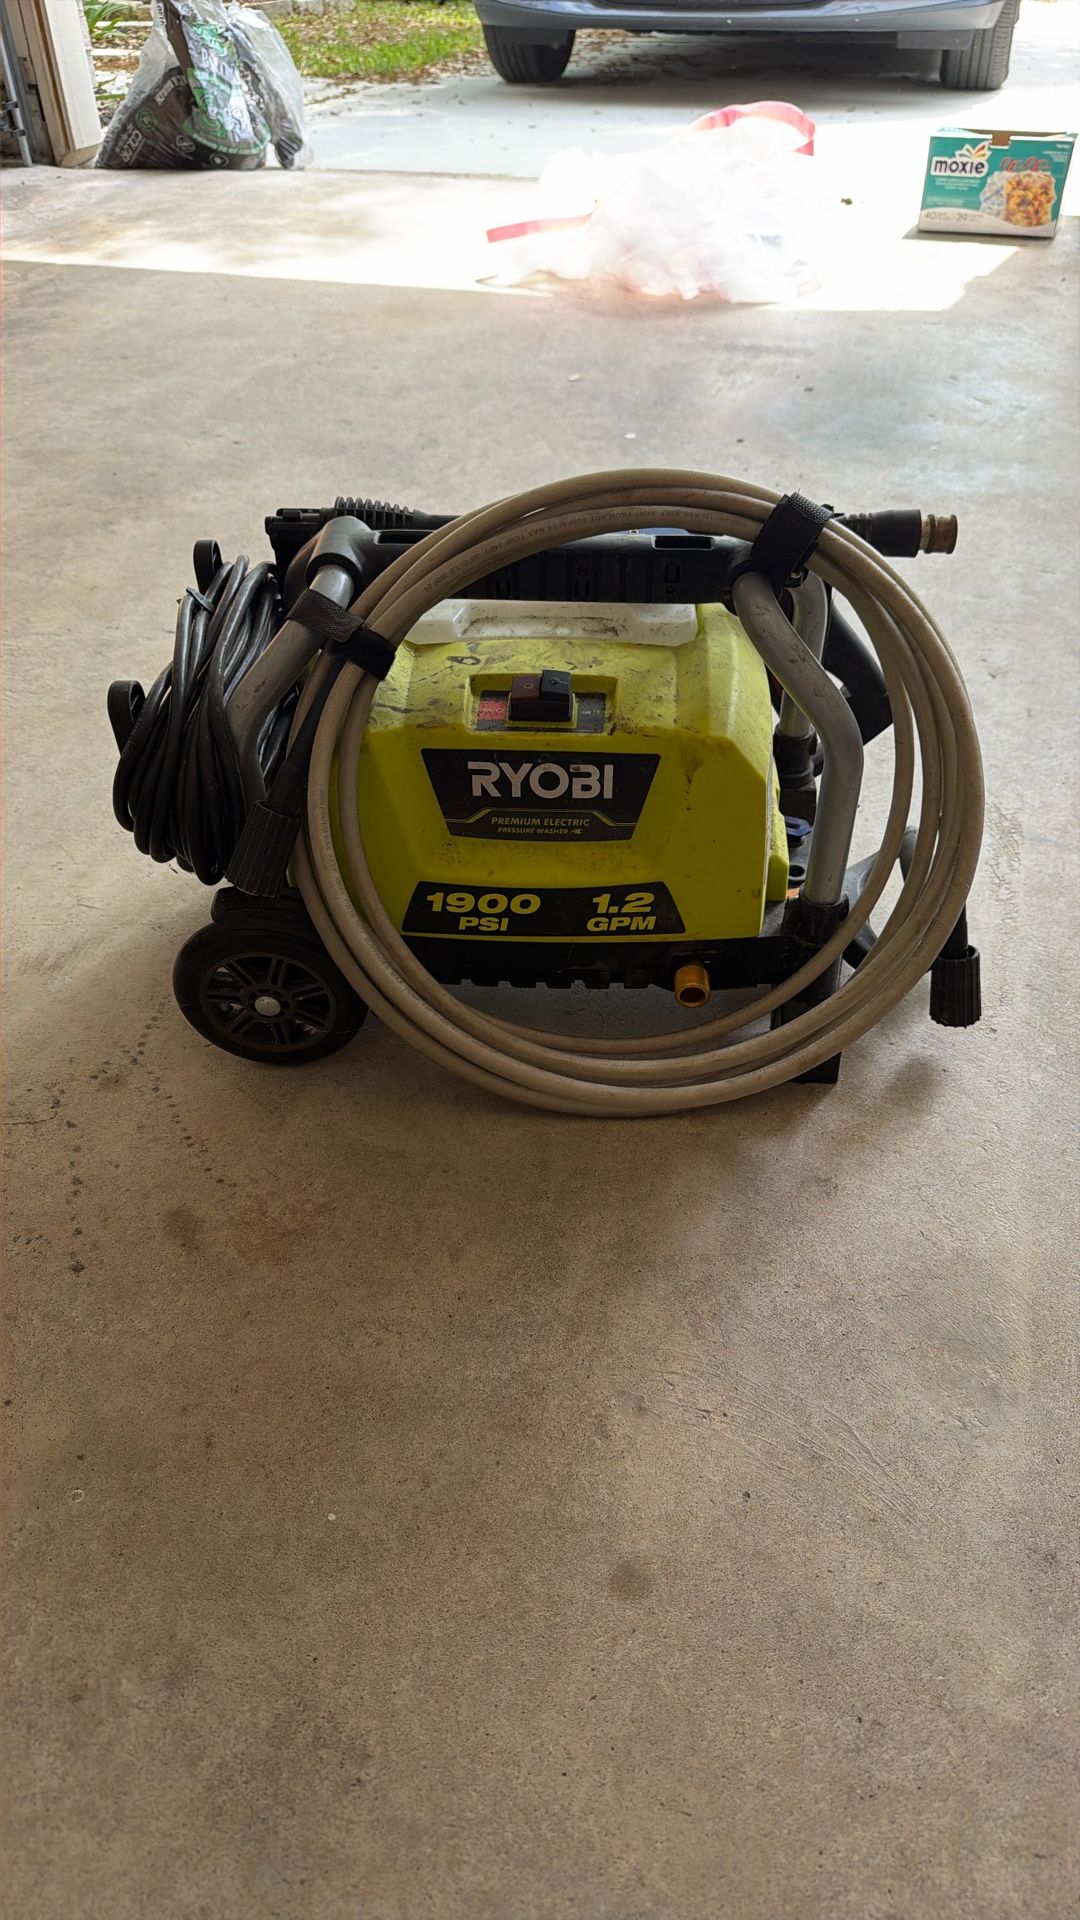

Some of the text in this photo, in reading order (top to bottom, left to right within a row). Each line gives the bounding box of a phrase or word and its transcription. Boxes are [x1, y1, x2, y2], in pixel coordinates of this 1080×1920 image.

[933, 159, 985, 174] moxie
[467, 761, 614, 800] RYOBI
[491, 817, 591, 827] PREMIUM ELECTRIC
[426, 892, 541, 915] 1900
[592, 892, 656, 914] 1.2
[458, 916, 509, 932] PSI
[586, 916, 656, 932] GPM
